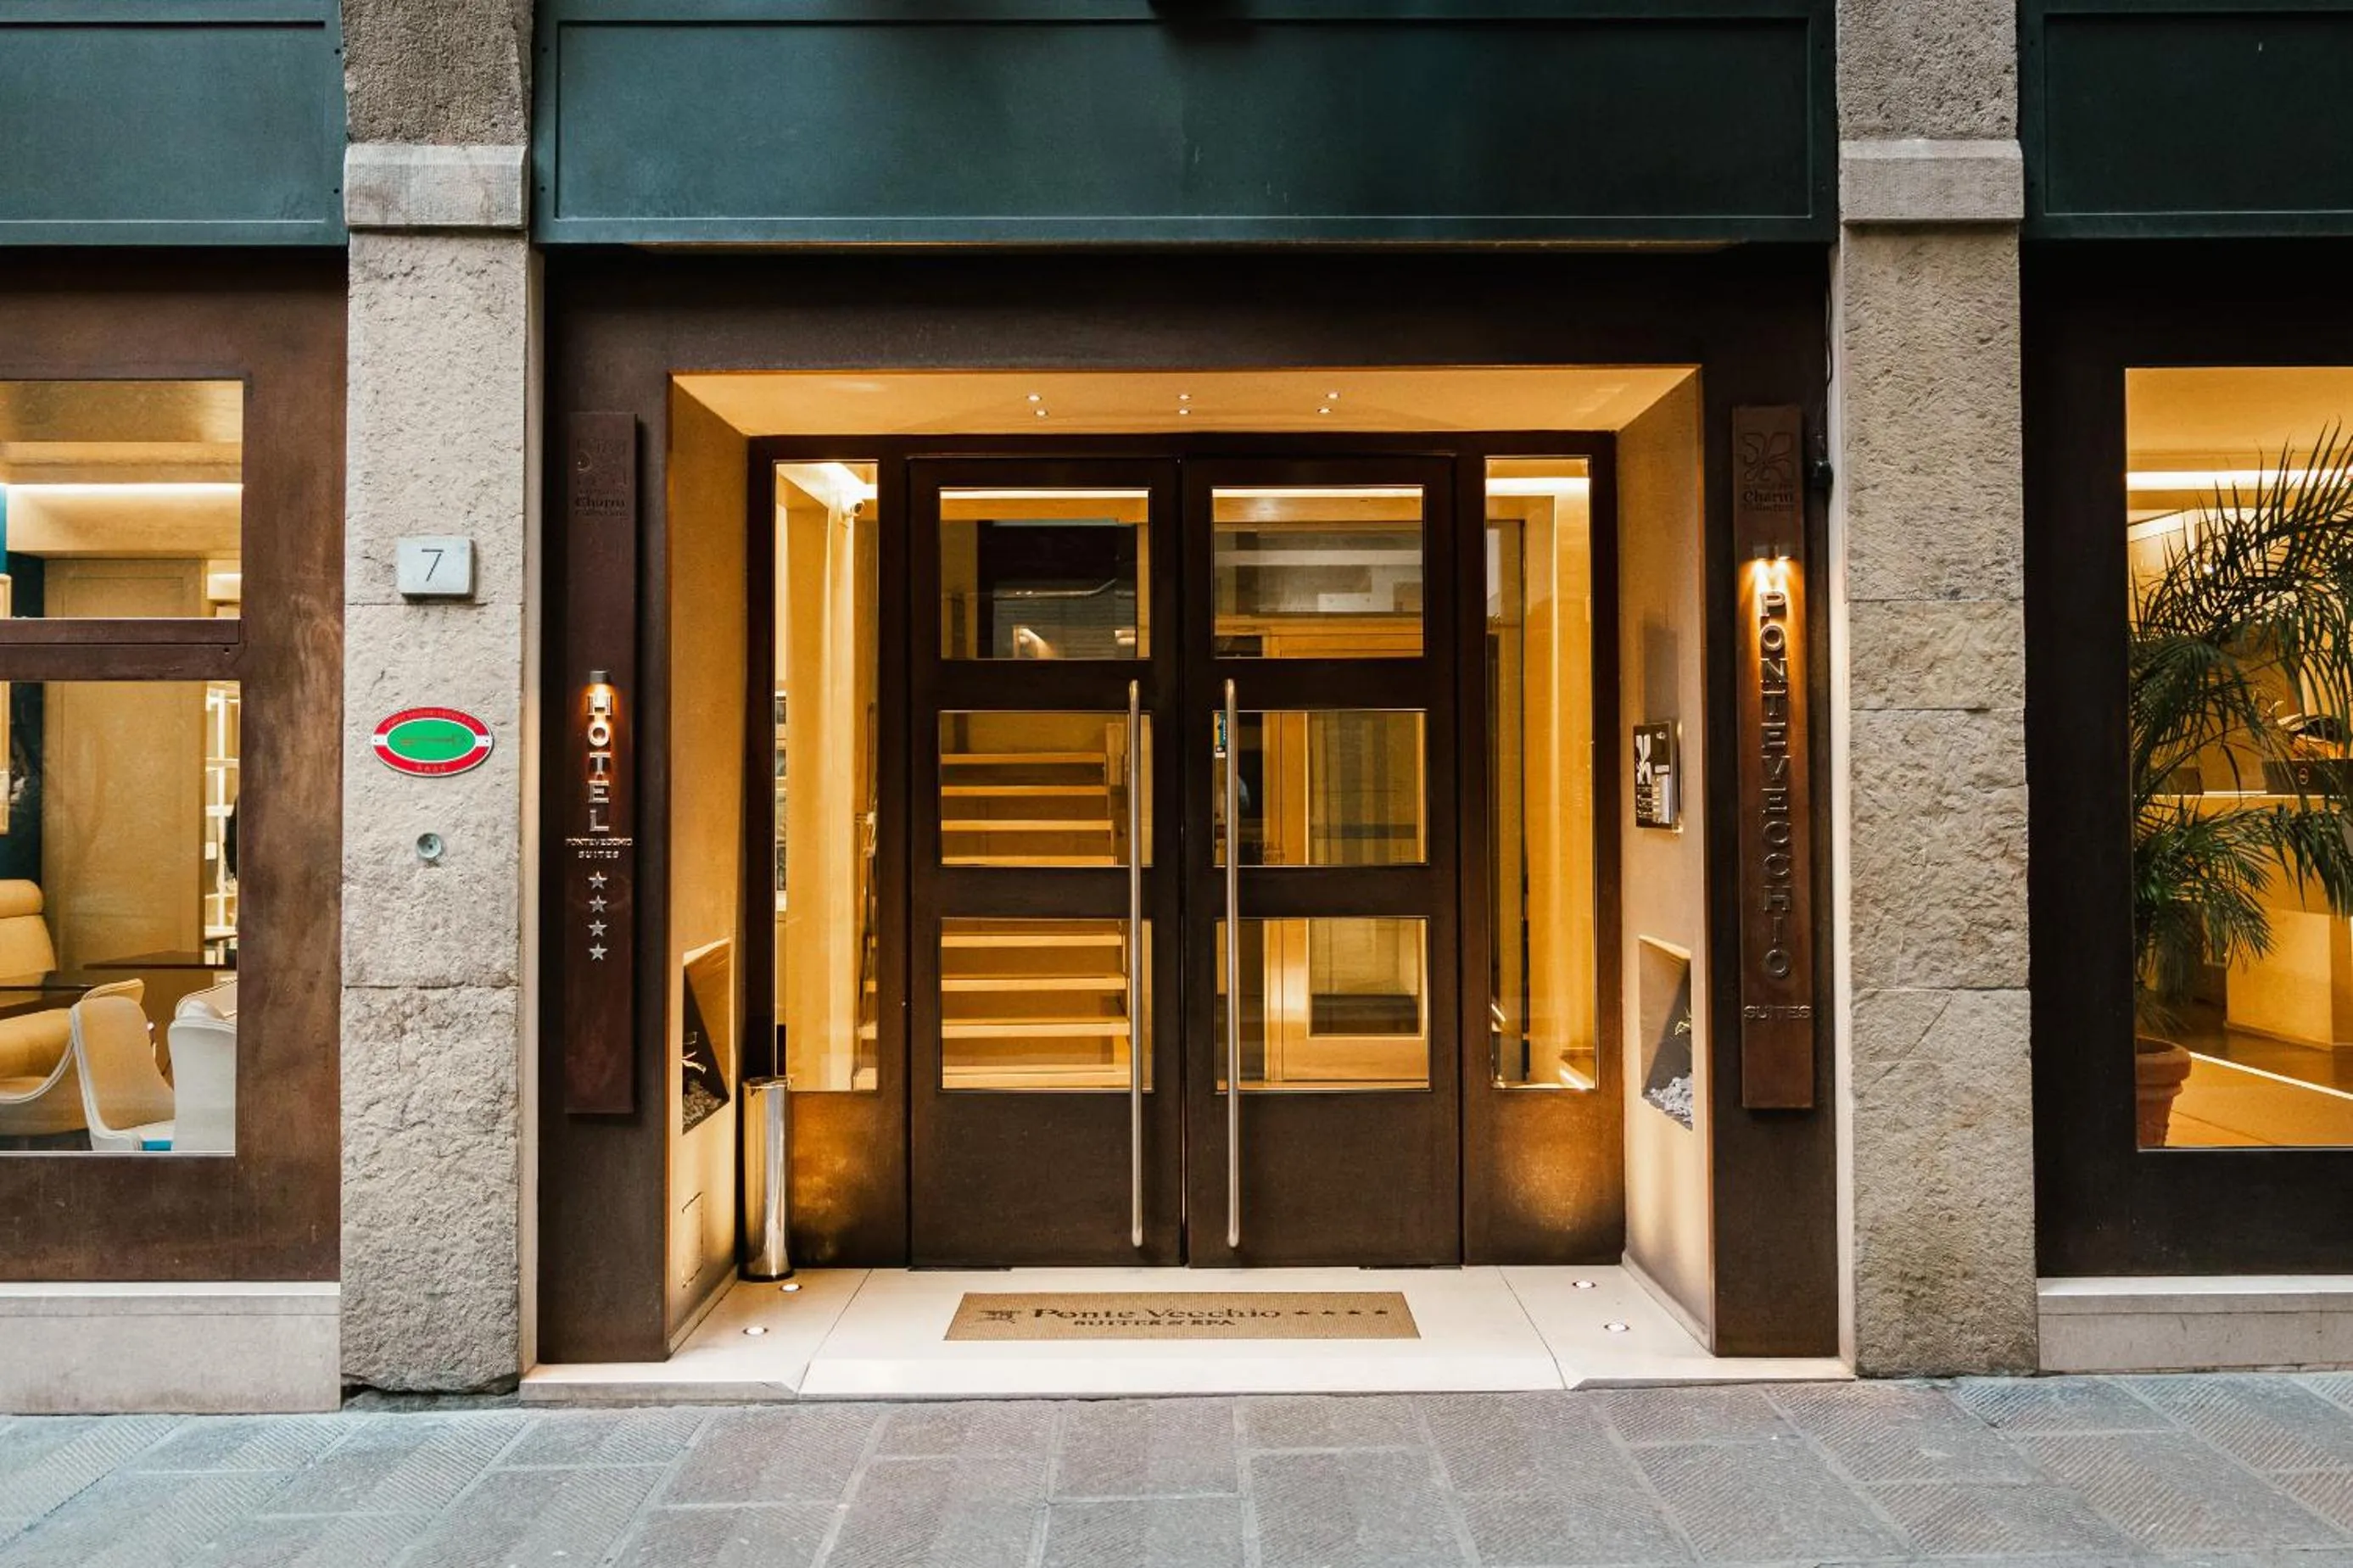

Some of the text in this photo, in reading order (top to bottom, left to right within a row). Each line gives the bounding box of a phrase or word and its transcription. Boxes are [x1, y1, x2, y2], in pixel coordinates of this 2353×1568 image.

[422, 550, 444, 582] 7
[587, 693, 612, 831] HOTEL
[1034, 1308, 1280, 1318] Ponte Vecchio
